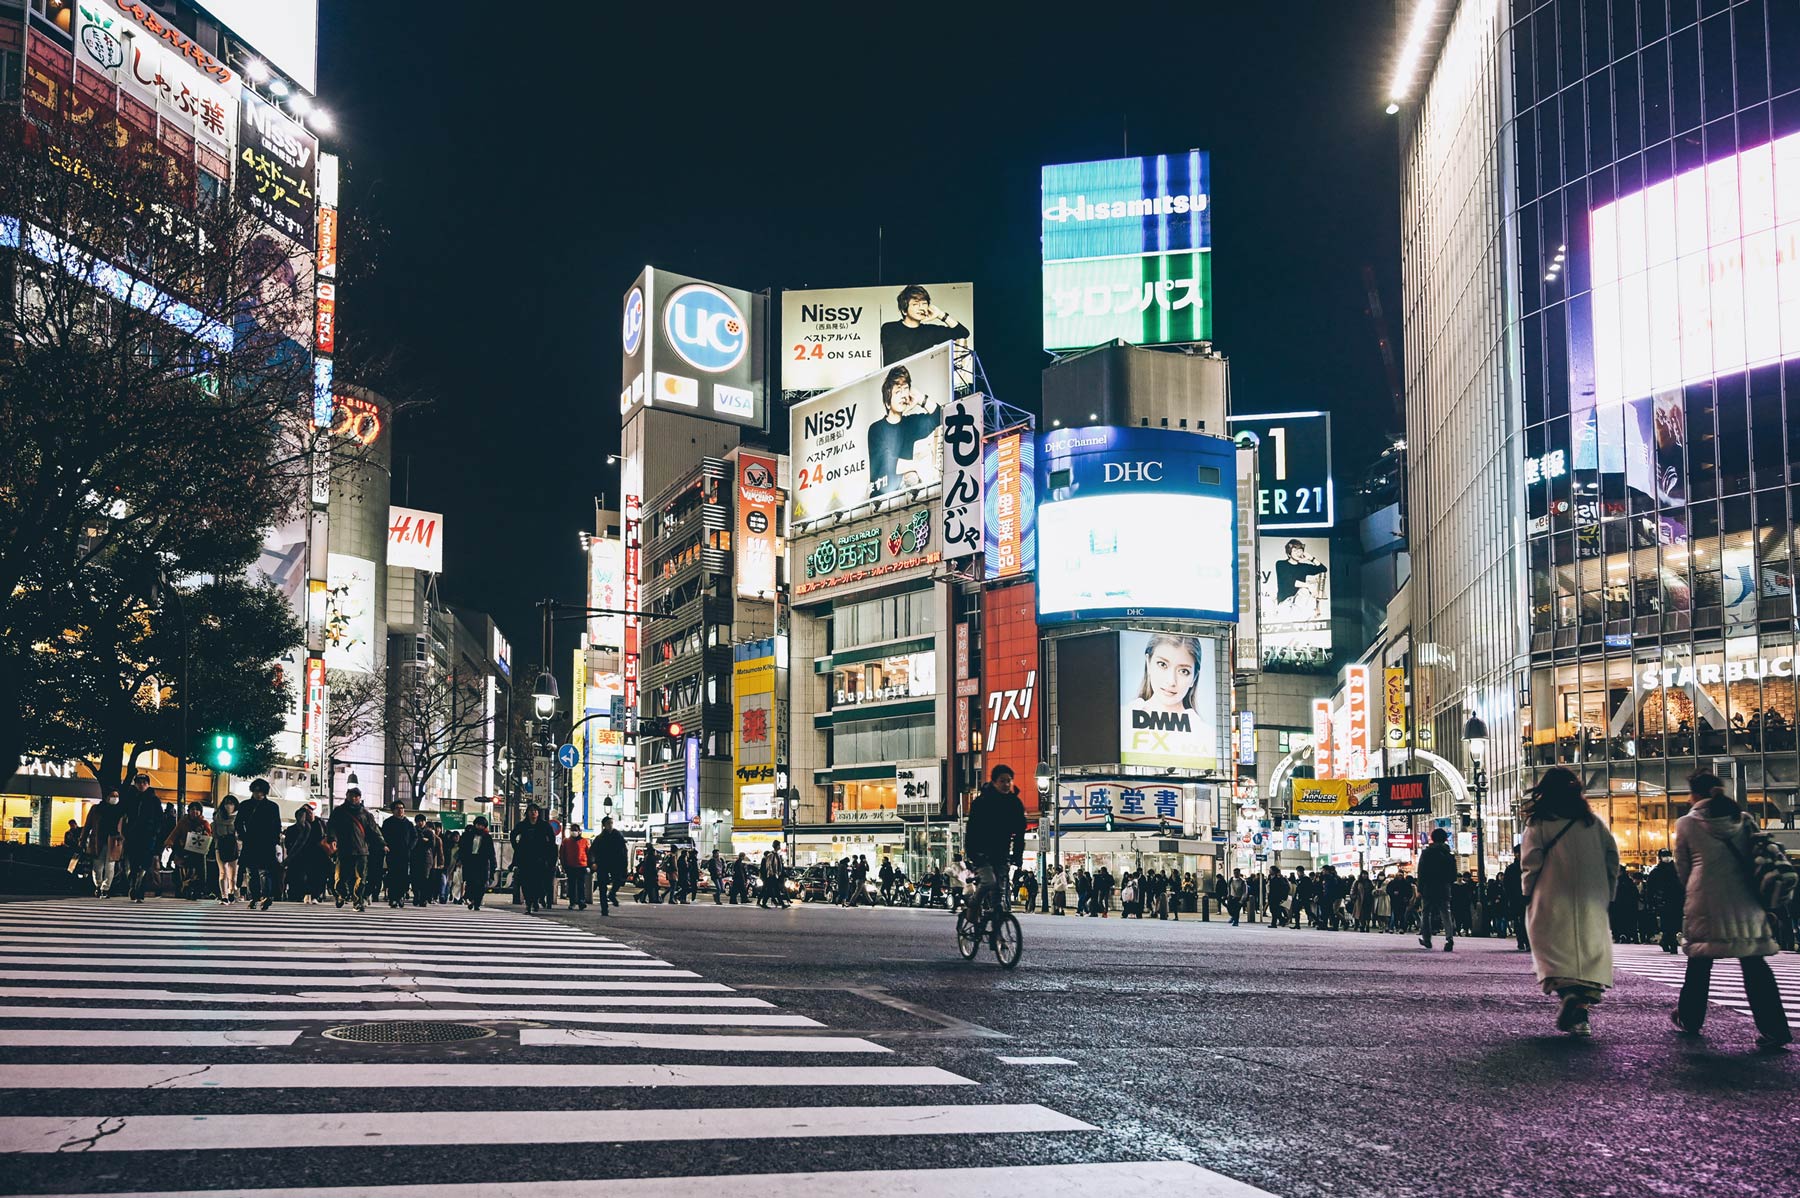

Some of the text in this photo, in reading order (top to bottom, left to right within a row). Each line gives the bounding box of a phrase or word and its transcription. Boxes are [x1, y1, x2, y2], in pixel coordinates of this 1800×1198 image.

[133, 47, 225, 136] しゃぶ葉
[1043, 193, 1208, 223] Hisamitsu
[1051, 278, 1203, 318] サロンパス
[802, 304, 863, 325] Nissy
[794, 344, 872, 361] 2.4 ON SALE
[804, 334, 861, 343] ベストアルバム
[719, 393, 752, 410] VISA
[804, 403, 858, 440] Nissy
[1045, 434, 1107, 453] DHC Channel
[799, 459, 866, 491] 2.4 ON SALE
[944, 403, 981, 550] もんじゃ
[1103, 460, 1163, 483] DHC
[998, 441, 1015, 568] 三千里薬品
[1296, 487, 1322, 513] 21
[389, 515, 435, 548] H&M
[838, 539, 880, 570] 西村
[1127, 608, 1145, 616] DHC
[1642, 656, 1800, 691] STARBUC
[986, 670, 1036, 752] クスリ
[1132, 709, 1192, 733] DMM
[1132, 731, 1171, 752] FX
